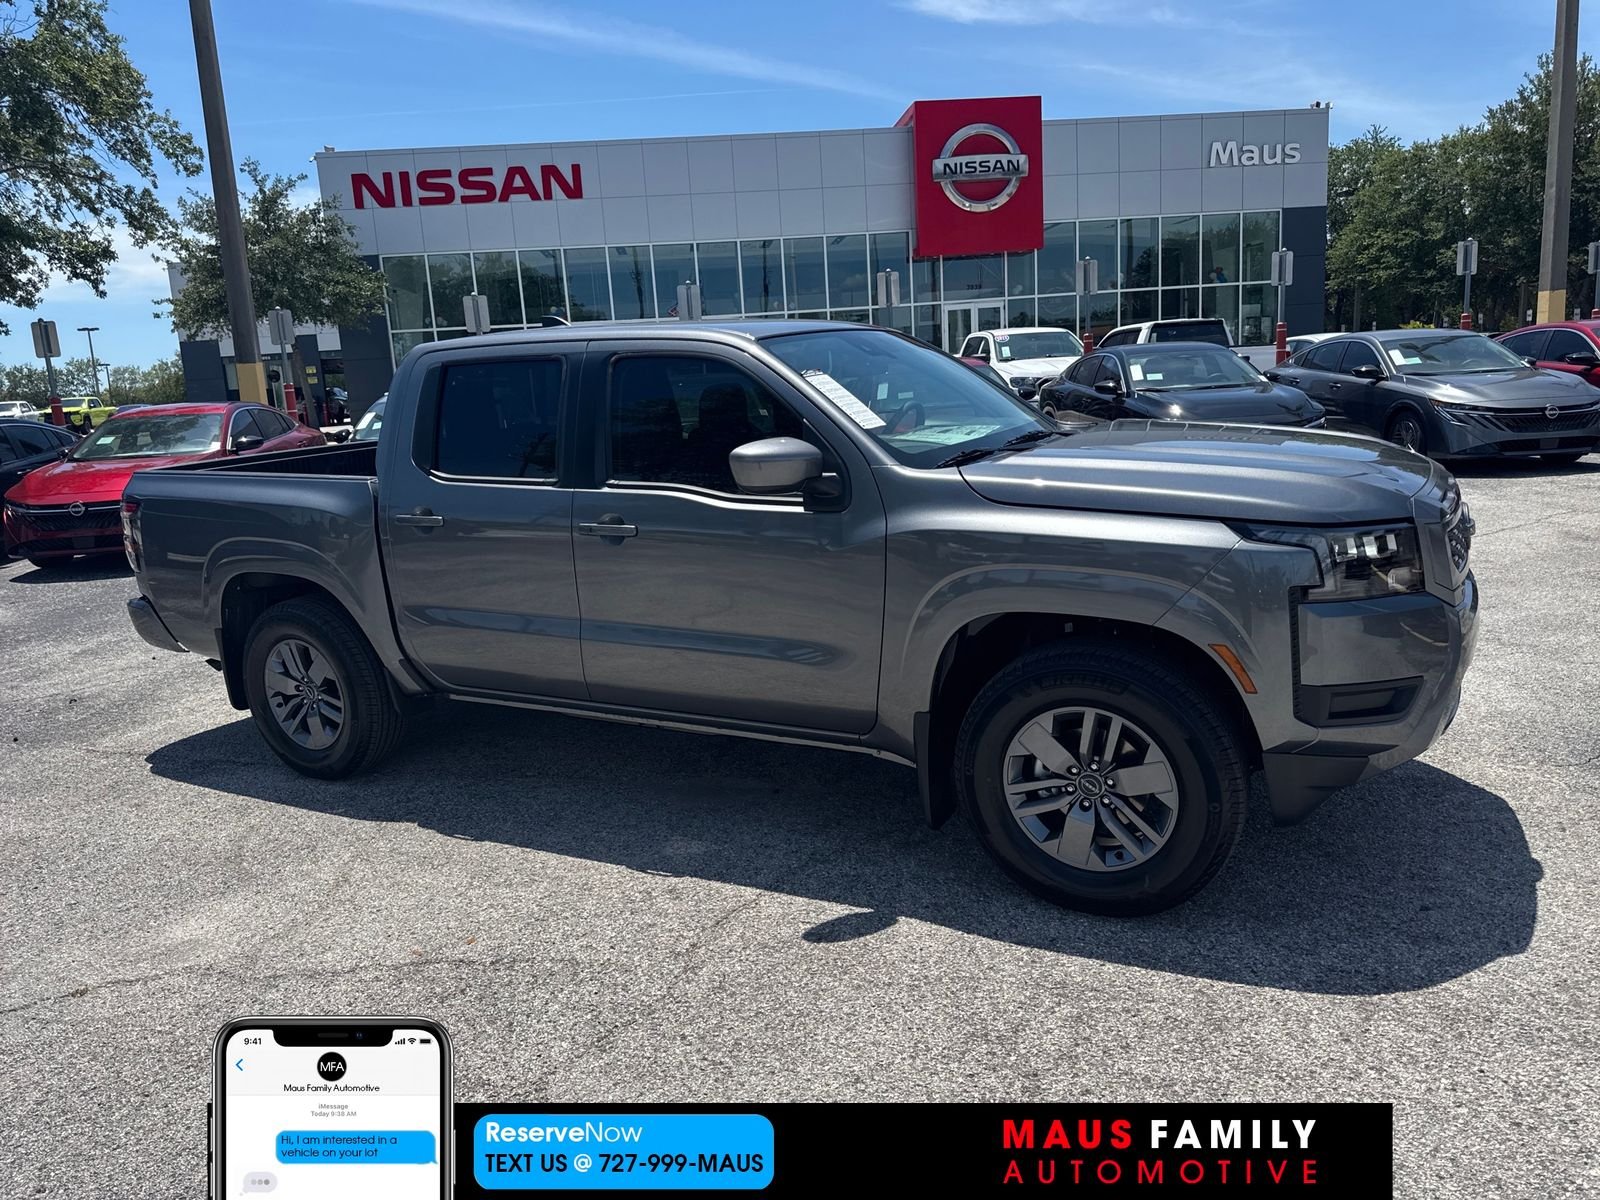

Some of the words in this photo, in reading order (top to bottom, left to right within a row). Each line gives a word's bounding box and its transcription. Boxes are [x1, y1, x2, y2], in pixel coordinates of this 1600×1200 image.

[942, 159, 1021, 176] NISSAN
[1208, 140, 1301, 168] Maus
[350, 163, 584, 209] NISSAN
